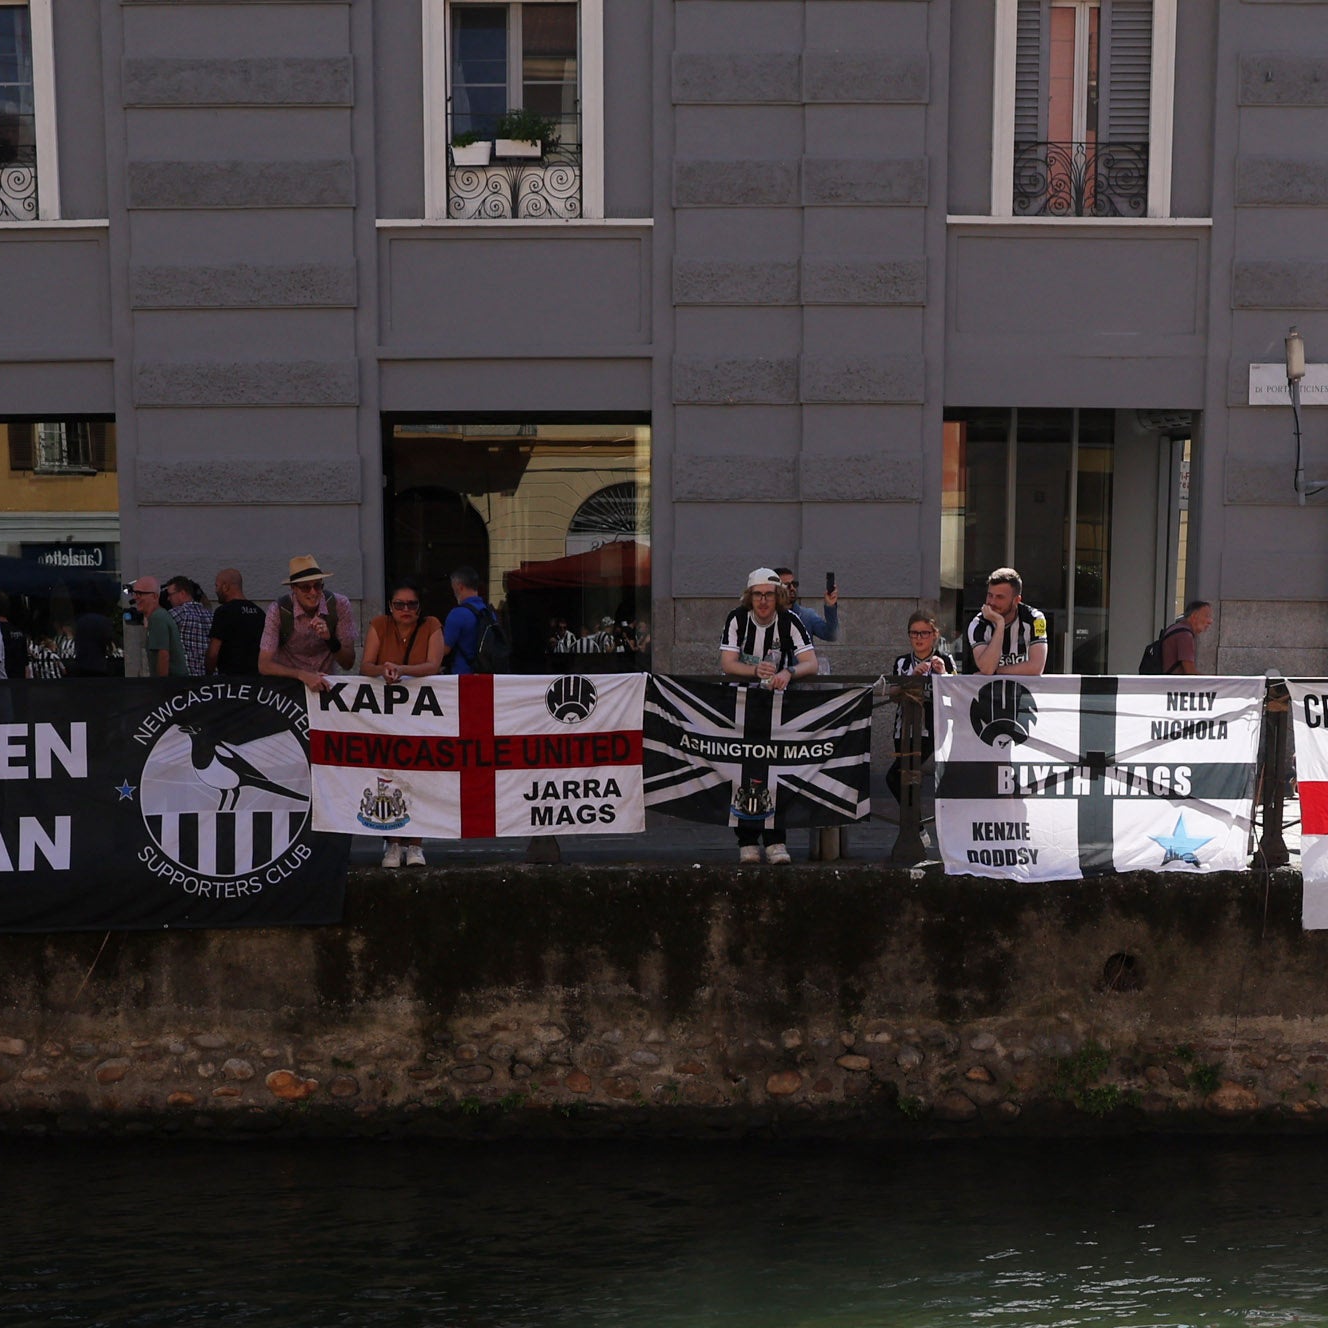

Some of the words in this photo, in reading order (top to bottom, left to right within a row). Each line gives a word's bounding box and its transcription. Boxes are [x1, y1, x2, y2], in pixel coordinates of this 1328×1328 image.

[1267, 385, 1292, 393] PORT
[319, 682, 445, 717] KAPA
[1166, 691, 1218, 712] NELLY
[133, 684, 252, 746] NEWCASTLE
[256, 687, 311, 742] UNITED
[1150, 720, 1228, 741] NICHOLA
[323, 734, 513, 768] NEWCASTLE
[523, 734, 631, 766] UNITED
[680, 734, 778, 759] ASHINGTON
[783, 742, 834, 759] MAGS
[523, 778, 622, 801] JARRA
[997, 765, 1091, 796] BLYTH
[1103, 765, 1193, 796] MAGS
[530, 803, 617, 827] MAGS
[971, 821, 1032, 842] KENZIE
[967, 847, 1039, 867] DODDSY
[137, 845, 264, 899] SUPPORTERS
[265, 843, 312, 885] CLUB
